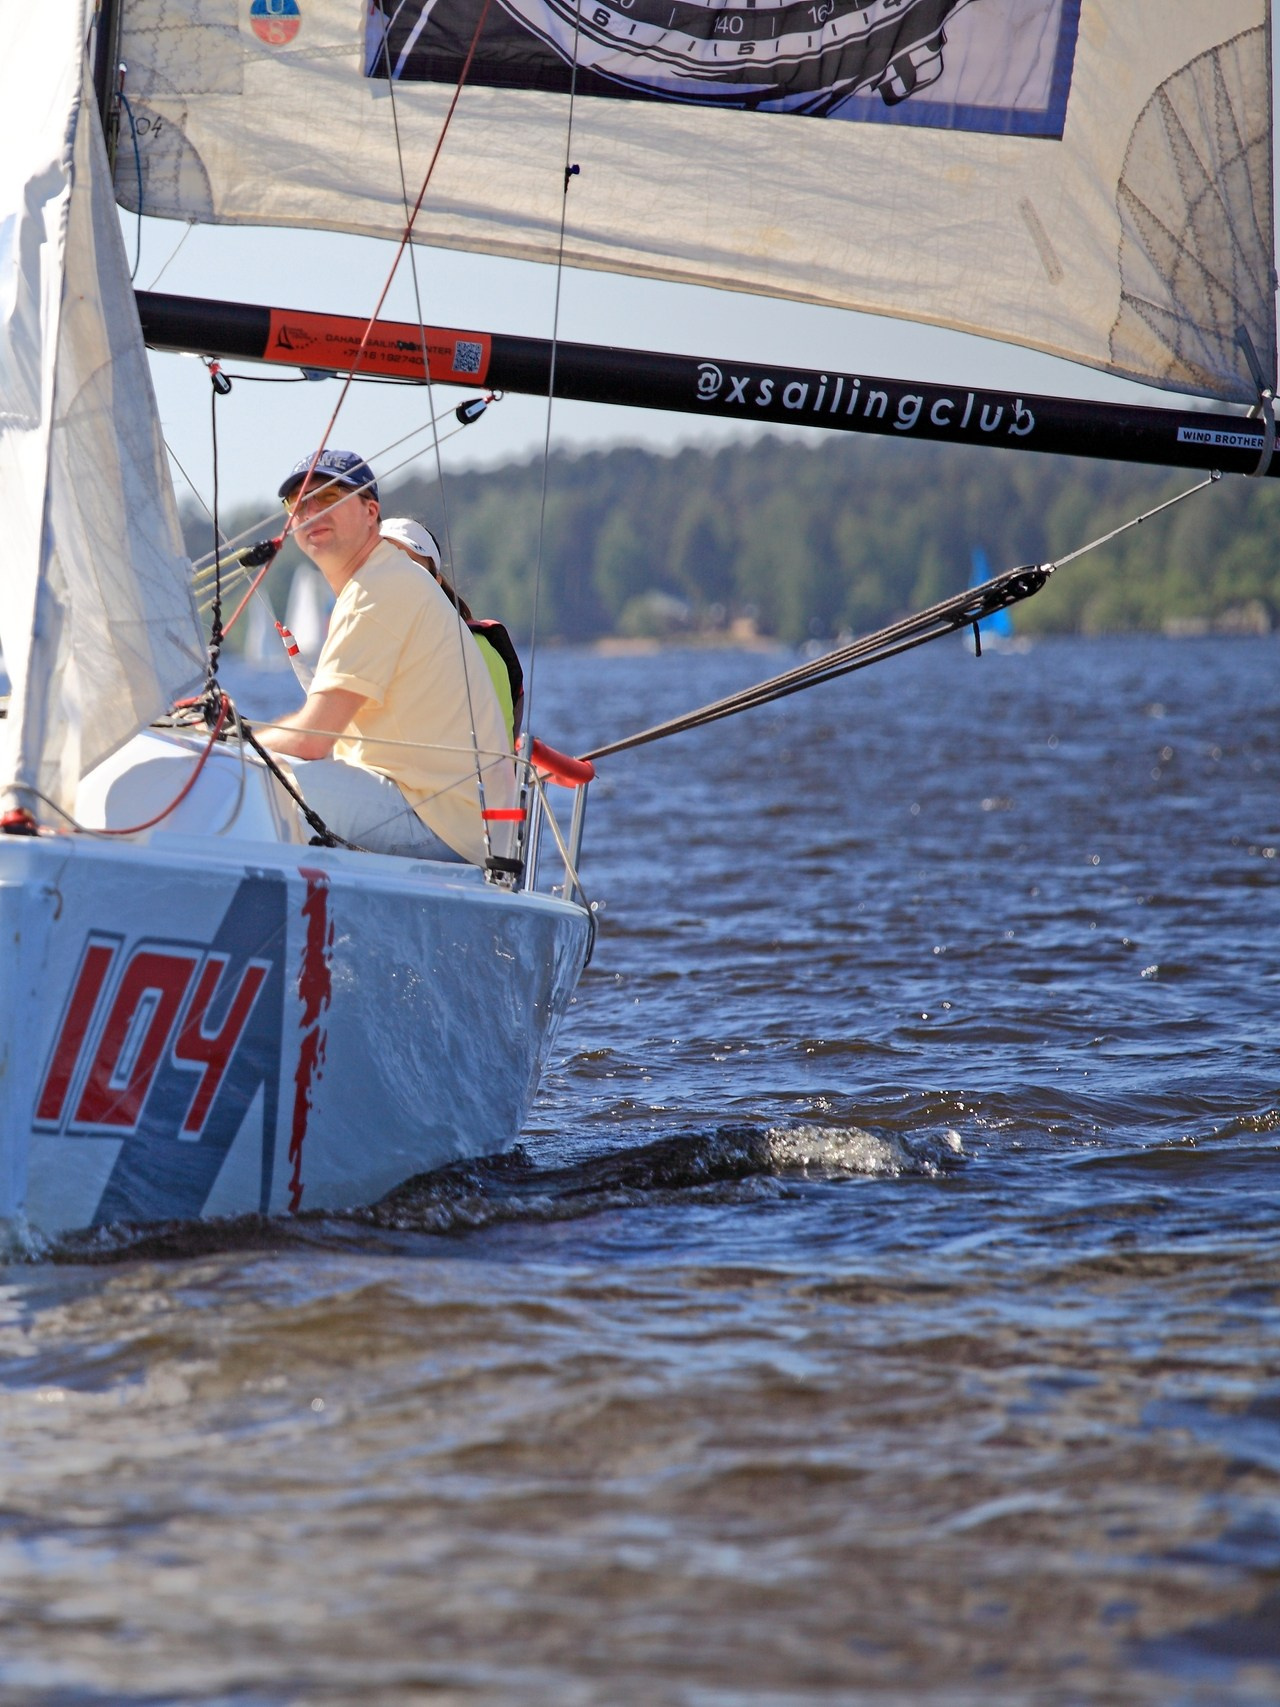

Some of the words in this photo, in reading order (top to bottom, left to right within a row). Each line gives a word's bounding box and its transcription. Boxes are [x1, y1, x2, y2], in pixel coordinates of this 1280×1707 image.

[592, 7, 611, 27] 6
[714, 16, 744, 34] 140
[737, 42, 756, 55] 5
[131, 115, 163, 138] 04
[366, 338, 400, 349] SAILIN
[695, 361, 1037, 437] @xsailingclub
[1182, 430, 1212, 442] WIND
[33, 934, 271, 1140] 104
